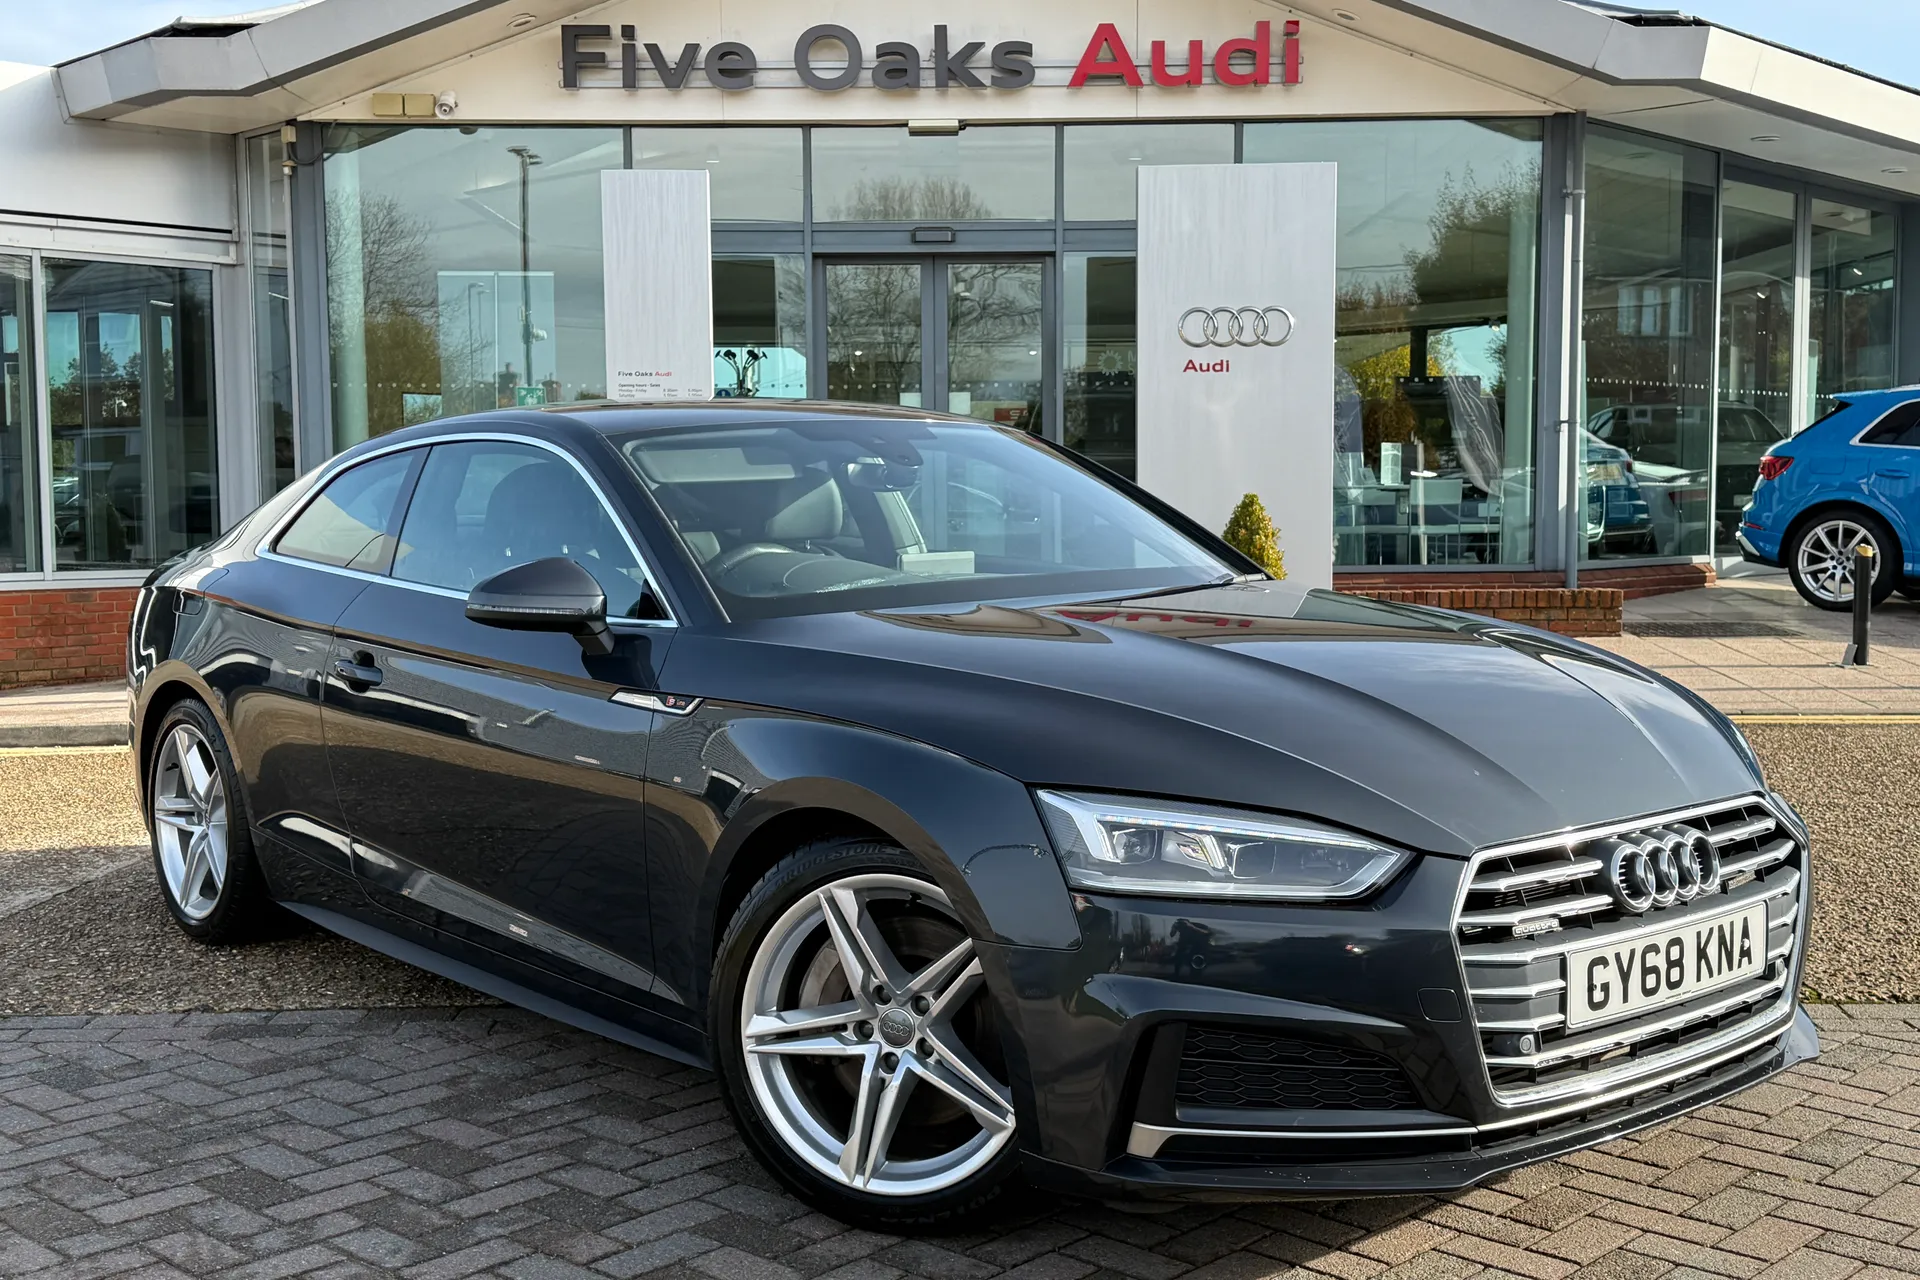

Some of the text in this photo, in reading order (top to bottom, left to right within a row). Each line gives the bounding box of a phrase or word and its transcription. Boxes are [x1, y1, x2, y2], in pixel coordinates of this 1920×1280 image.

[561, 20, 1300, 92] Five Oaks Audi
[1183, 359, 1230, 373] Audi
[1515, 919, 1558, 934] quattro
[1586, 916, 1753, 1012] GY68 KNA
